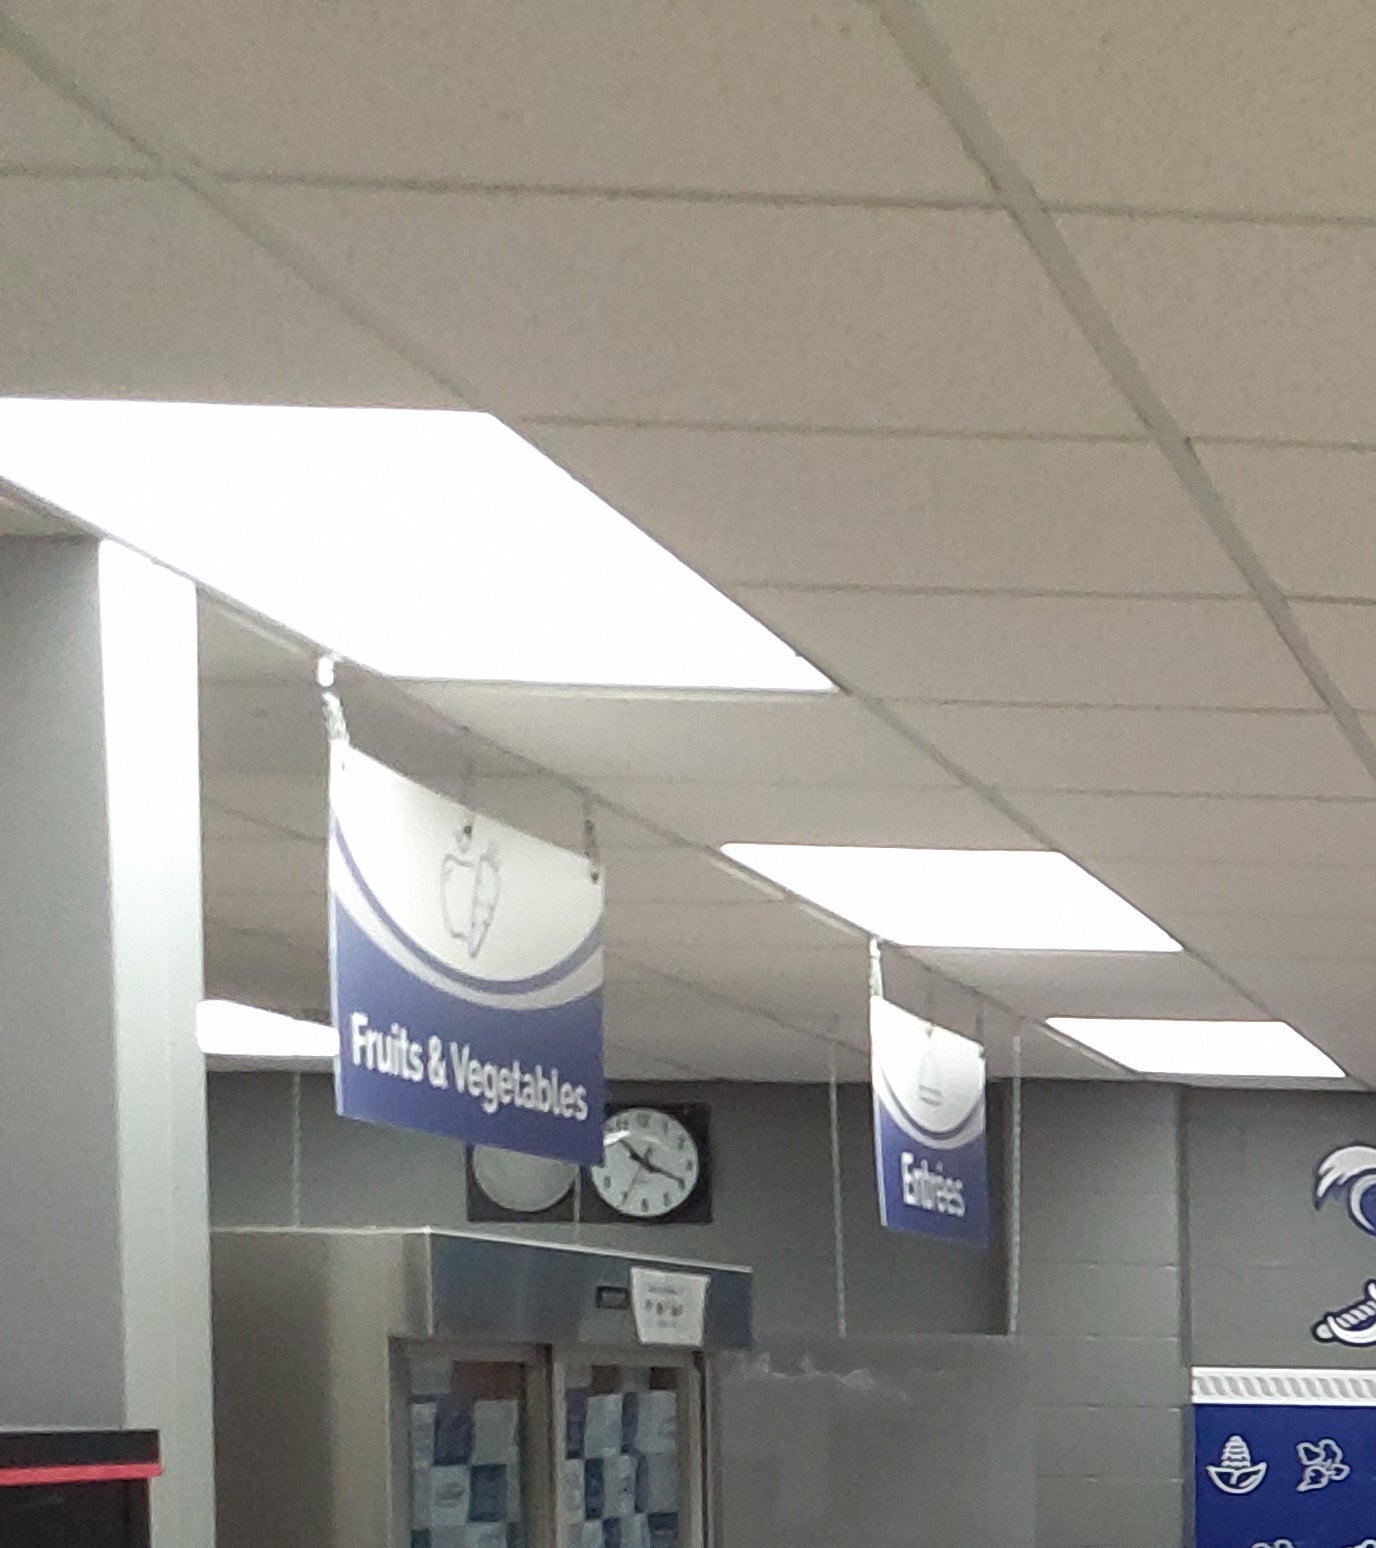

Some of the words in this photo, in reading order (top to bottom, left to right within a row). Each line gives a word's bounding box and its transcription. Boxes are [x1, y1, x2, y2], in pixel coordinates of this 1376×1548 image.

[350, 1010, 424, 1082] Fruits
[427, 1035, 449, 1089] &
[450, 1042, 588, 1121] Vegetables
